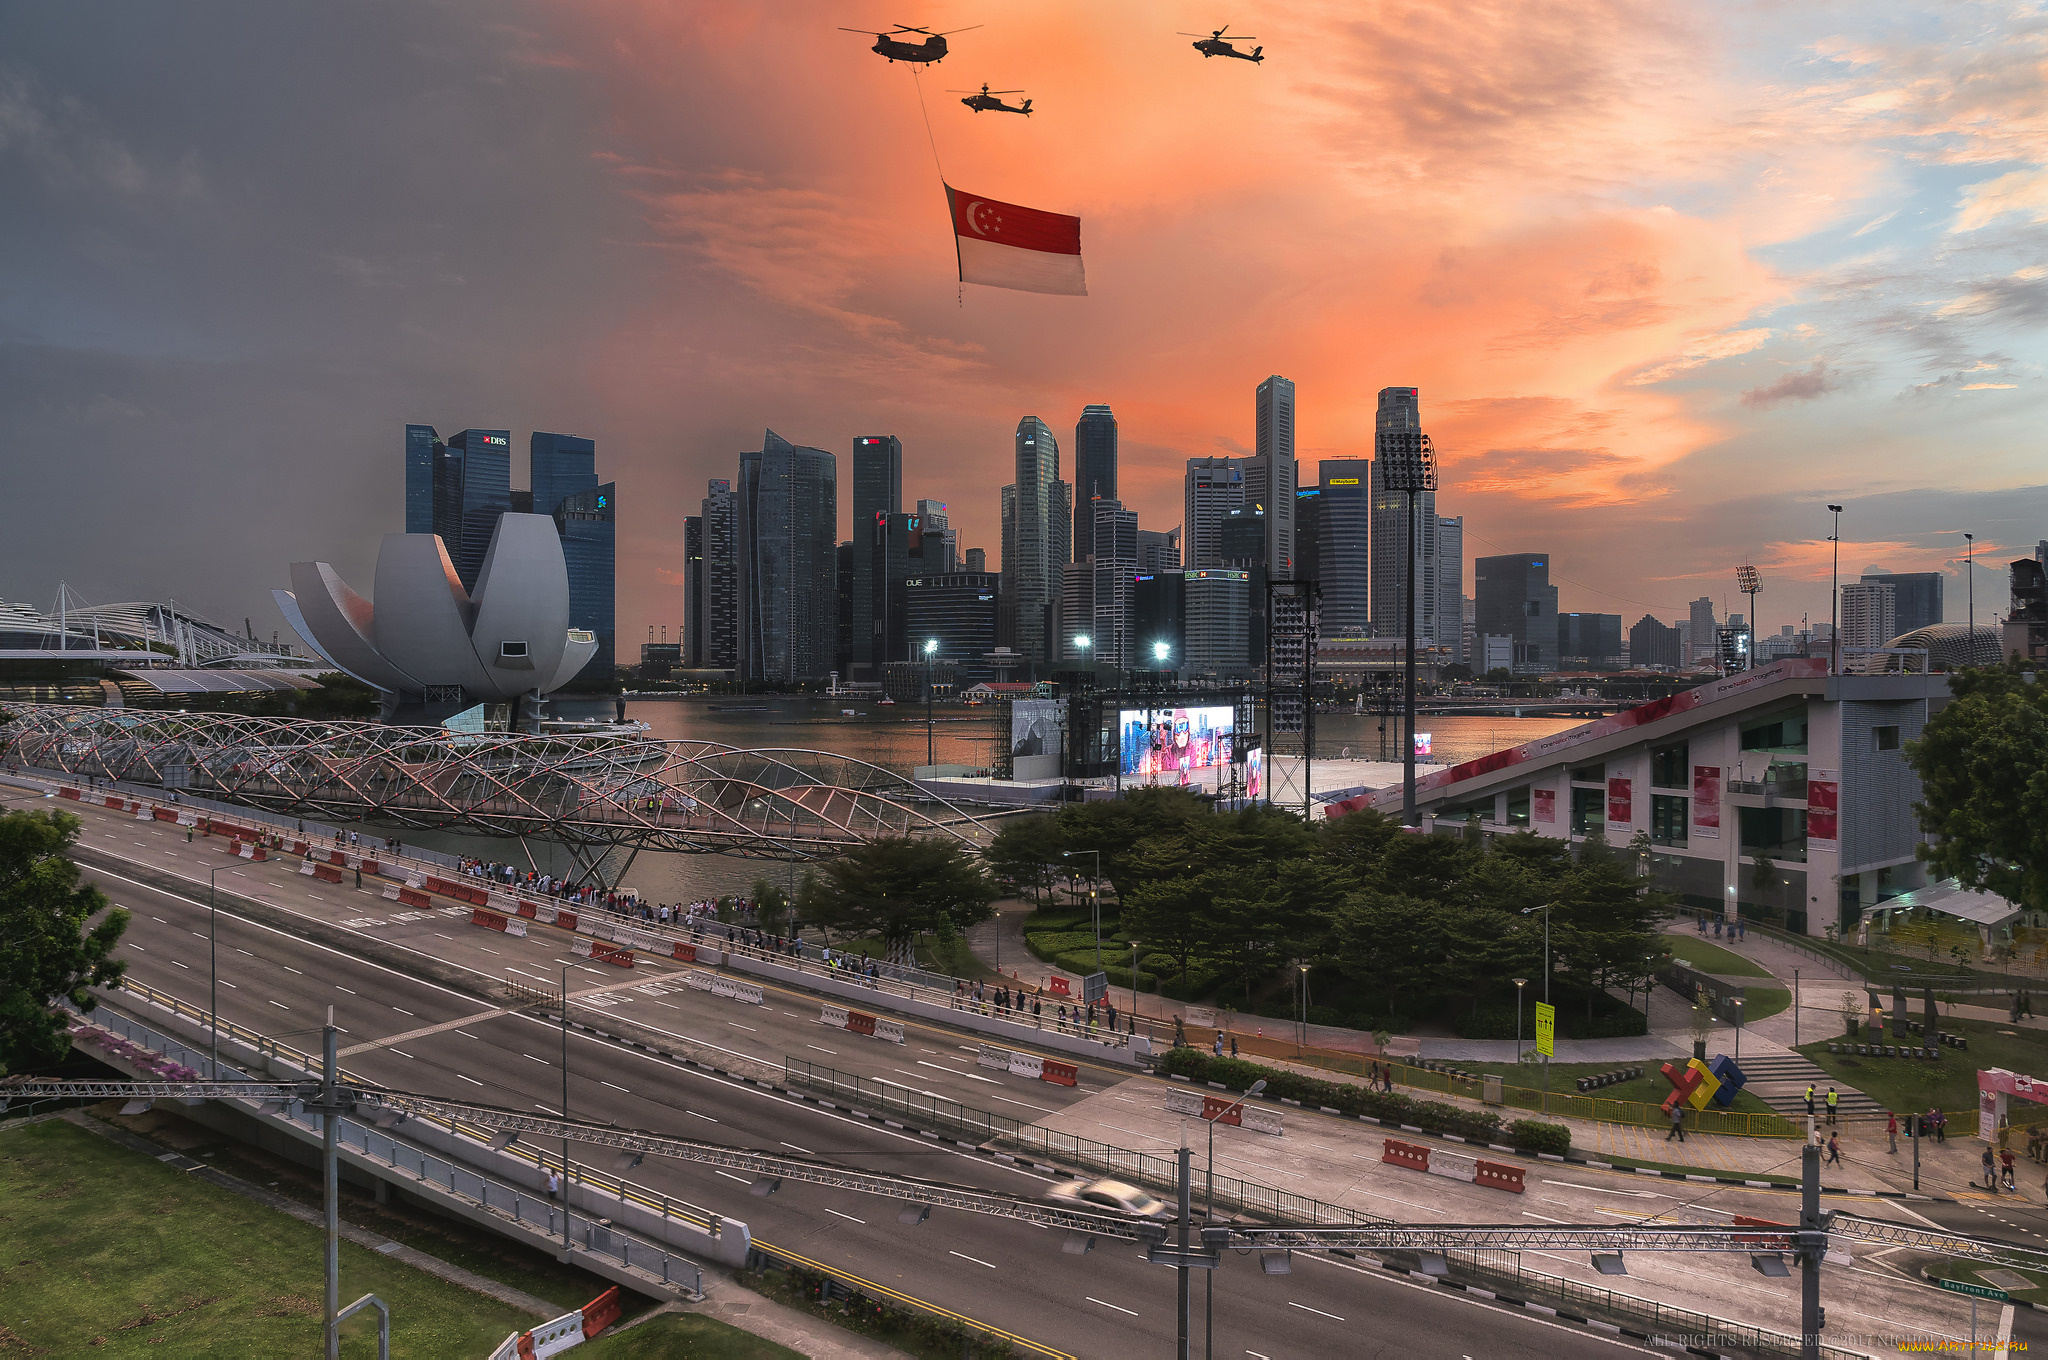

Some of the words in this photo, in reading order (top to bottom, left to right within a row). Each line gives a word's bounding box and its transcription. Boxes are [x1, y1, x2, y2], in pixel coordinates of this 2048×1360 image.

[491, 437, 506, 445] DBS
[1944, 1281, 1985, 1295] Bayfront
[1987, 1289, 2005, 1299] Ave
